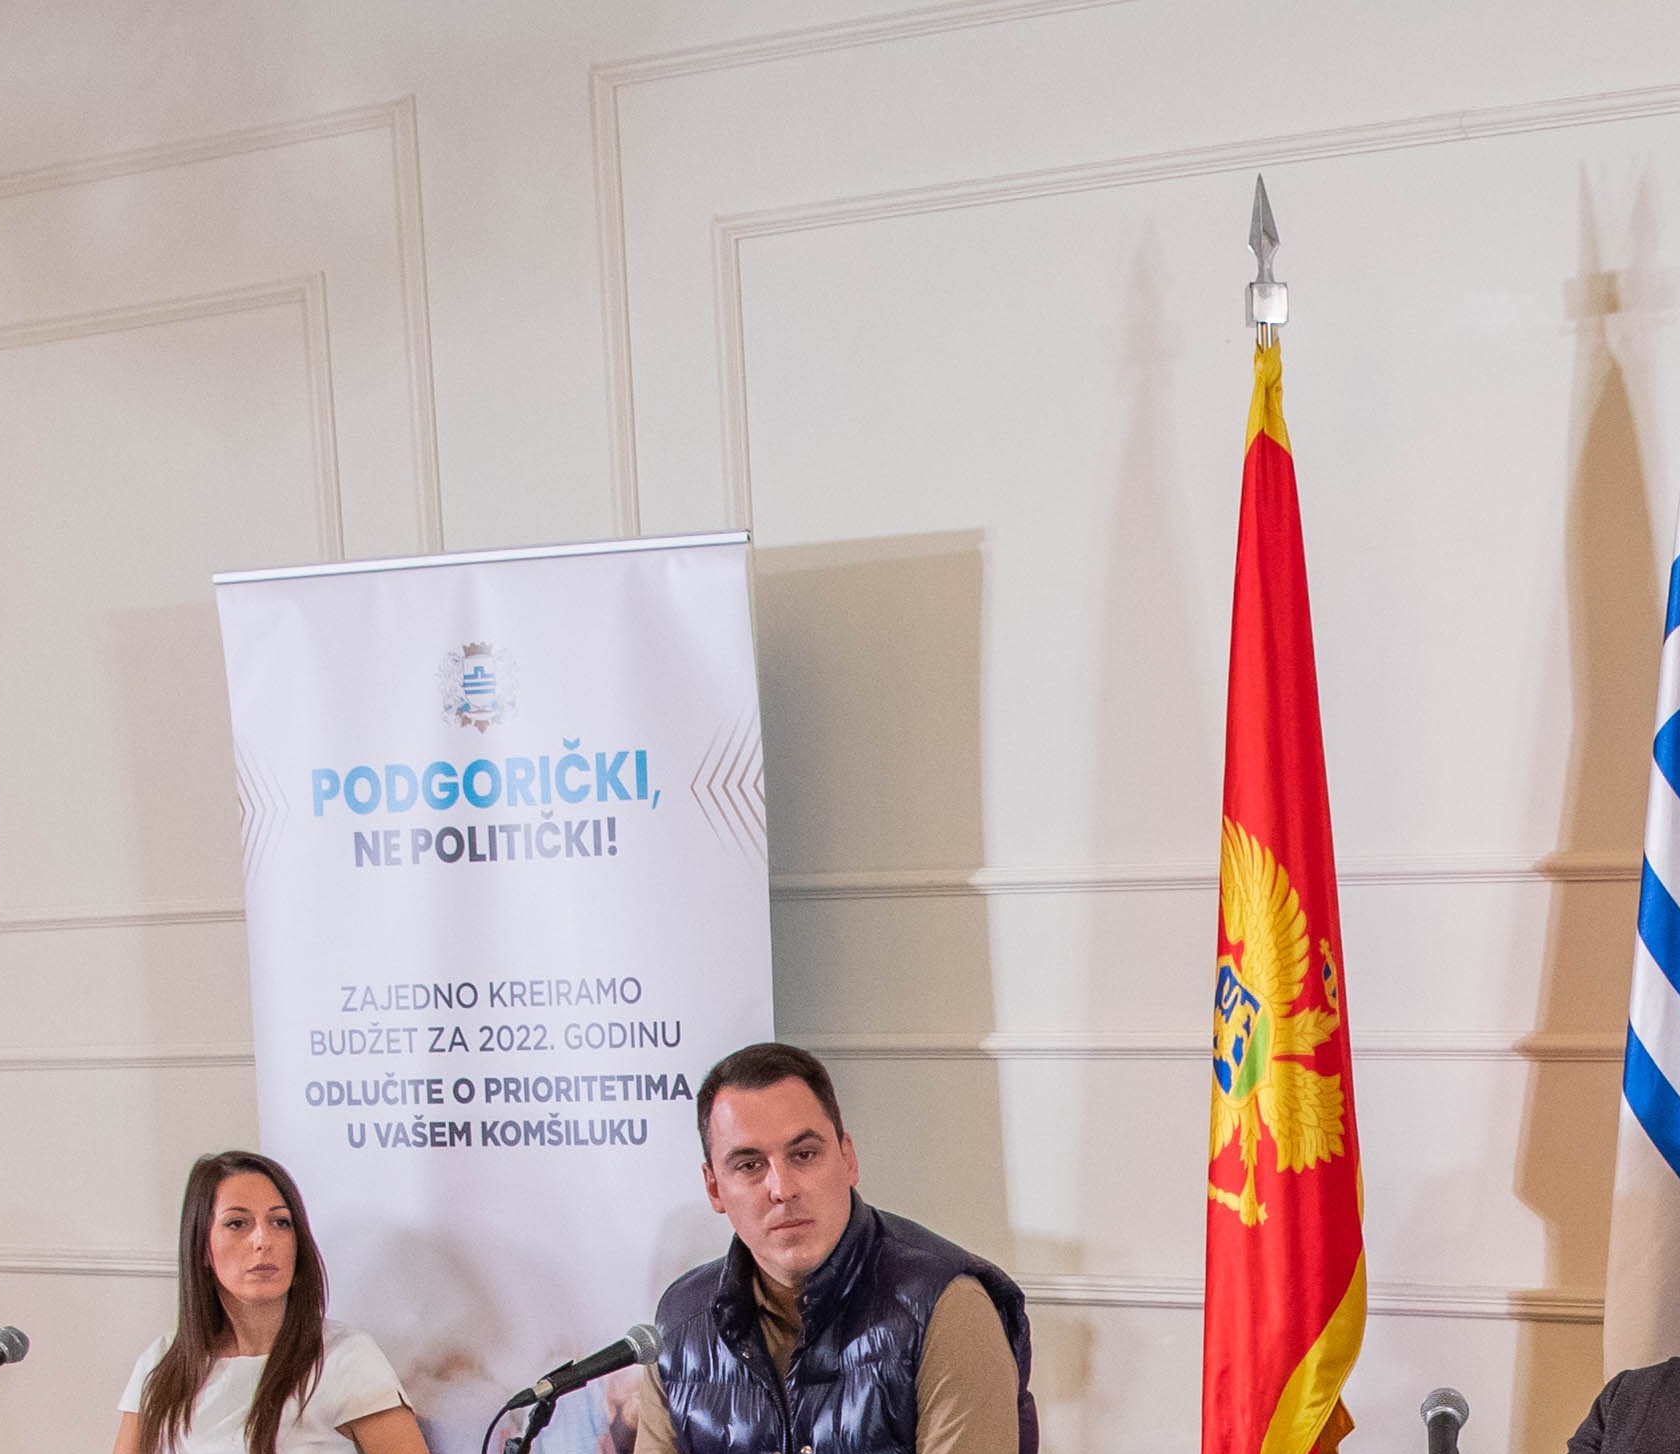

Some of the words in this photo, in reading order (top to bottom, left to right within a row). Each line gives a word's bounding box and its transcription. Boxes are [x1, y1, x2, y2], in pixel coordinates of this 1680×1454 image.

[312, 737, 661, 817] PODGORIČKI,
[353, 829, 402, 868] NE
[410, 809, 618, 865] POLITIČKI!
[340, 982, 479, 1013] ZAJEDNO
[489, 976, 643, 1008] KREIRAMO
[310, 1022, 419, 1056] BUDŽET
[427, 1026, 470, 1053] ZA
[478, 1024, 555, 1053] 2022.
[564, 1020, 682, 1050] GODINU
[304, 1072, 445, 1107] ODLUČITE
[452, 1078, 476, 1105] O
[484, 1073, 694, 1103] PRIORITETIMA
[347, 1122, 366, 1149] U
[374, 1115, 473, 1148] VAŠEM
[481, 1112, 648, 1148] KOMŠILUKU
